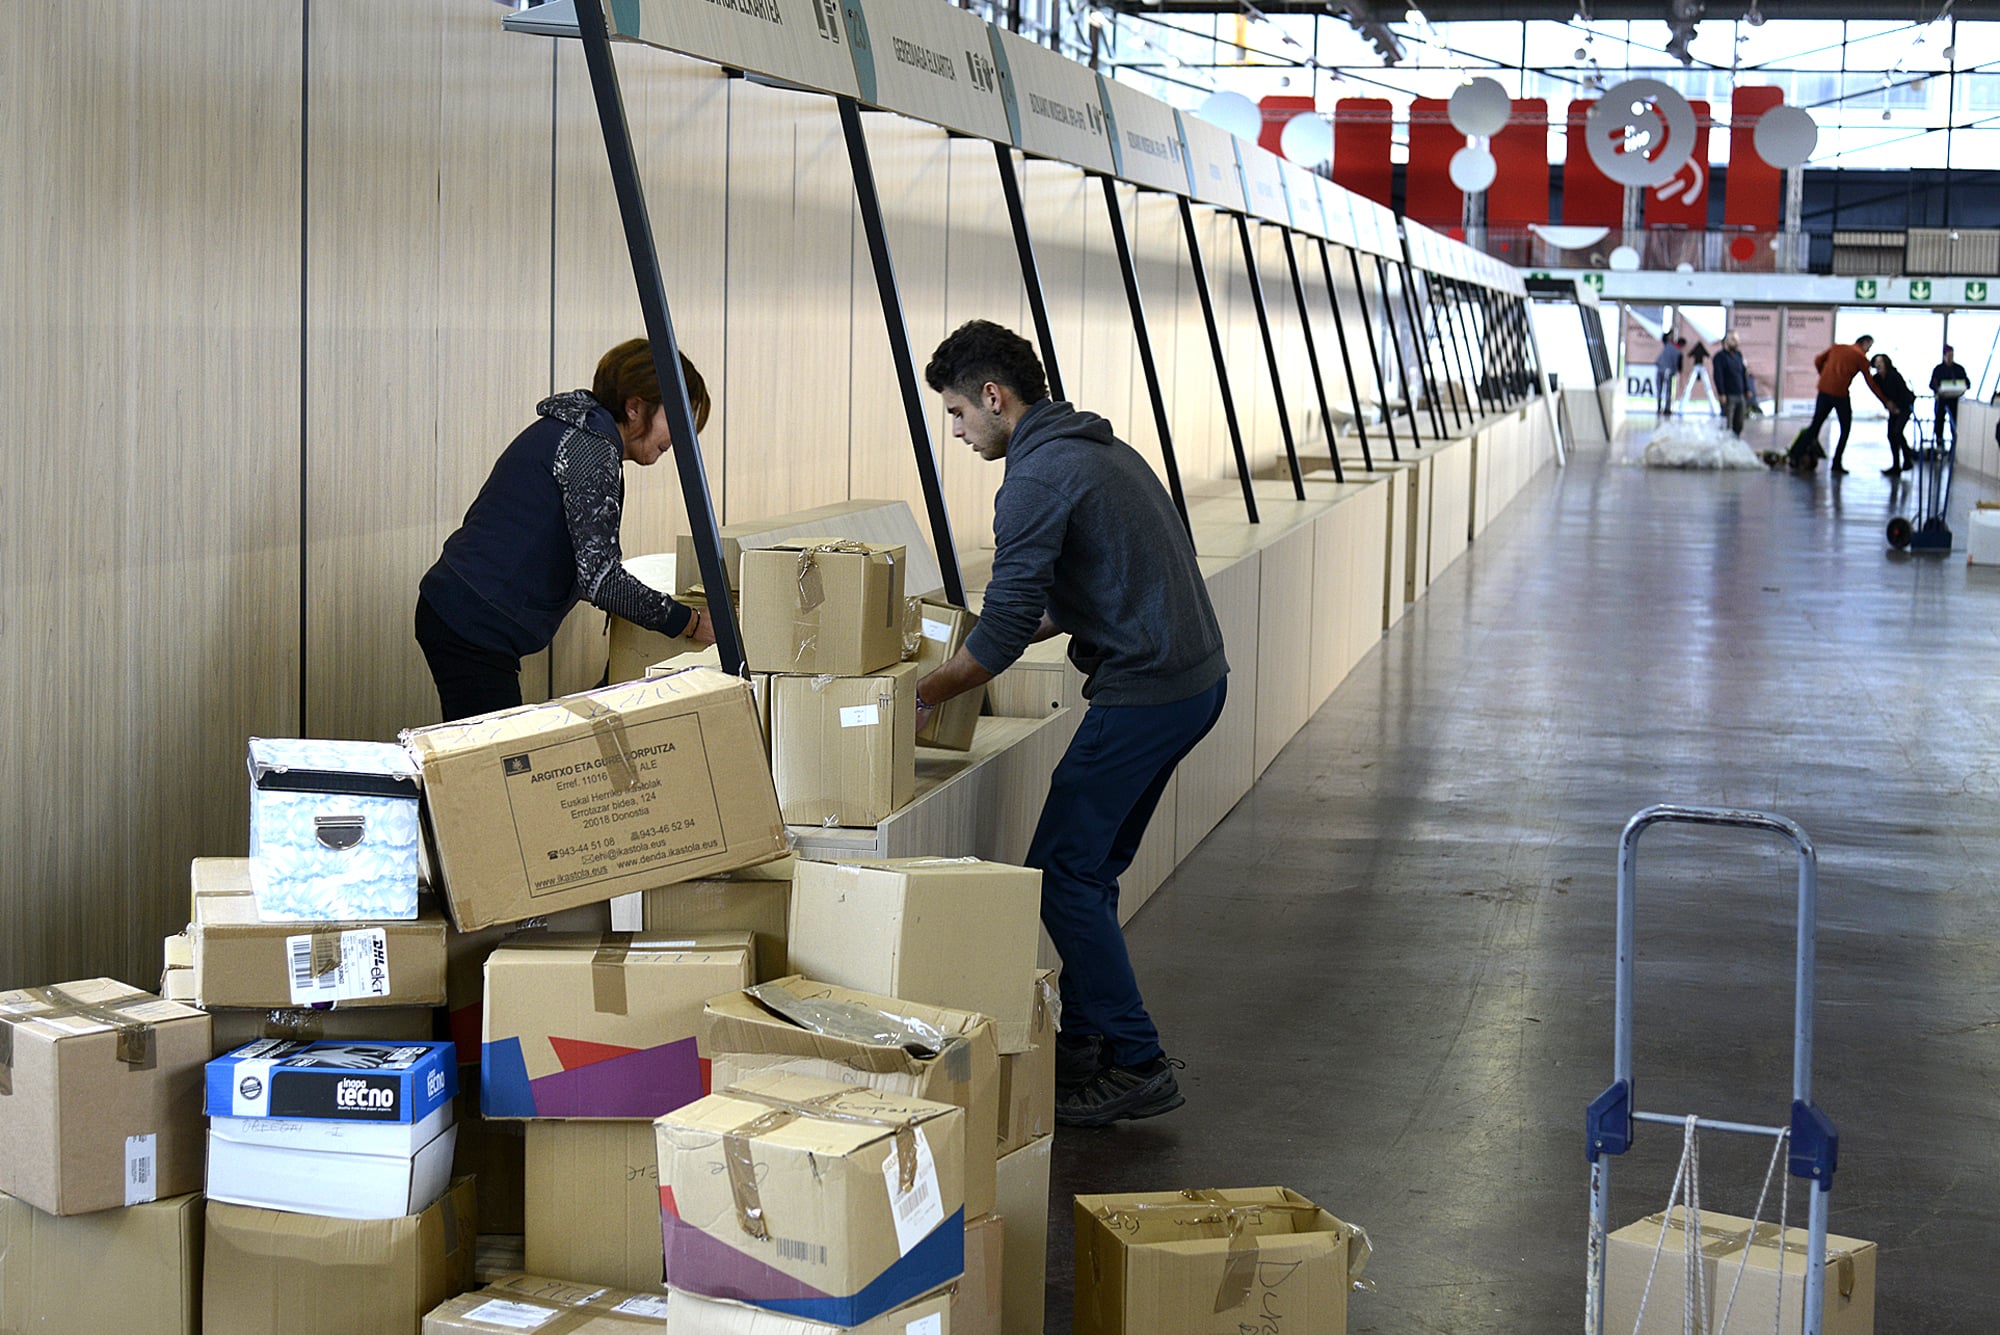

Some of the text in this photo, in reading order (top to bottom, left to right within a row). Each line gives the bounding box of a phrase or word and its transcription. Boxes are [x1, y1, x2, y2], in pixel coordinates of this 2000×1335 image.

[531, 766, 574, 784] ARGITXO
[575, 761, 593, 773] ETA
[556, 779, 579, 791] Erref.
[582, 771, 608, 785] 11016
[640, 760, 658, 772] ALE
[560, 795, 590, 809] Euskal
[591, 789, 623, 802] Herriko
[570, 791, 657, 820] Errotazar bidea, 124
[583, 806, 650, 829] 20018 Donostia
[558, 818, 696, 858] 943-44 51 08 943-46 52 94
[534, 839, 719, 889] www.ikastola.eus www.denda.ikastola.eus
[373, 940, 385, 965] DHL
[337, 1081, 394, 1107] tecno
